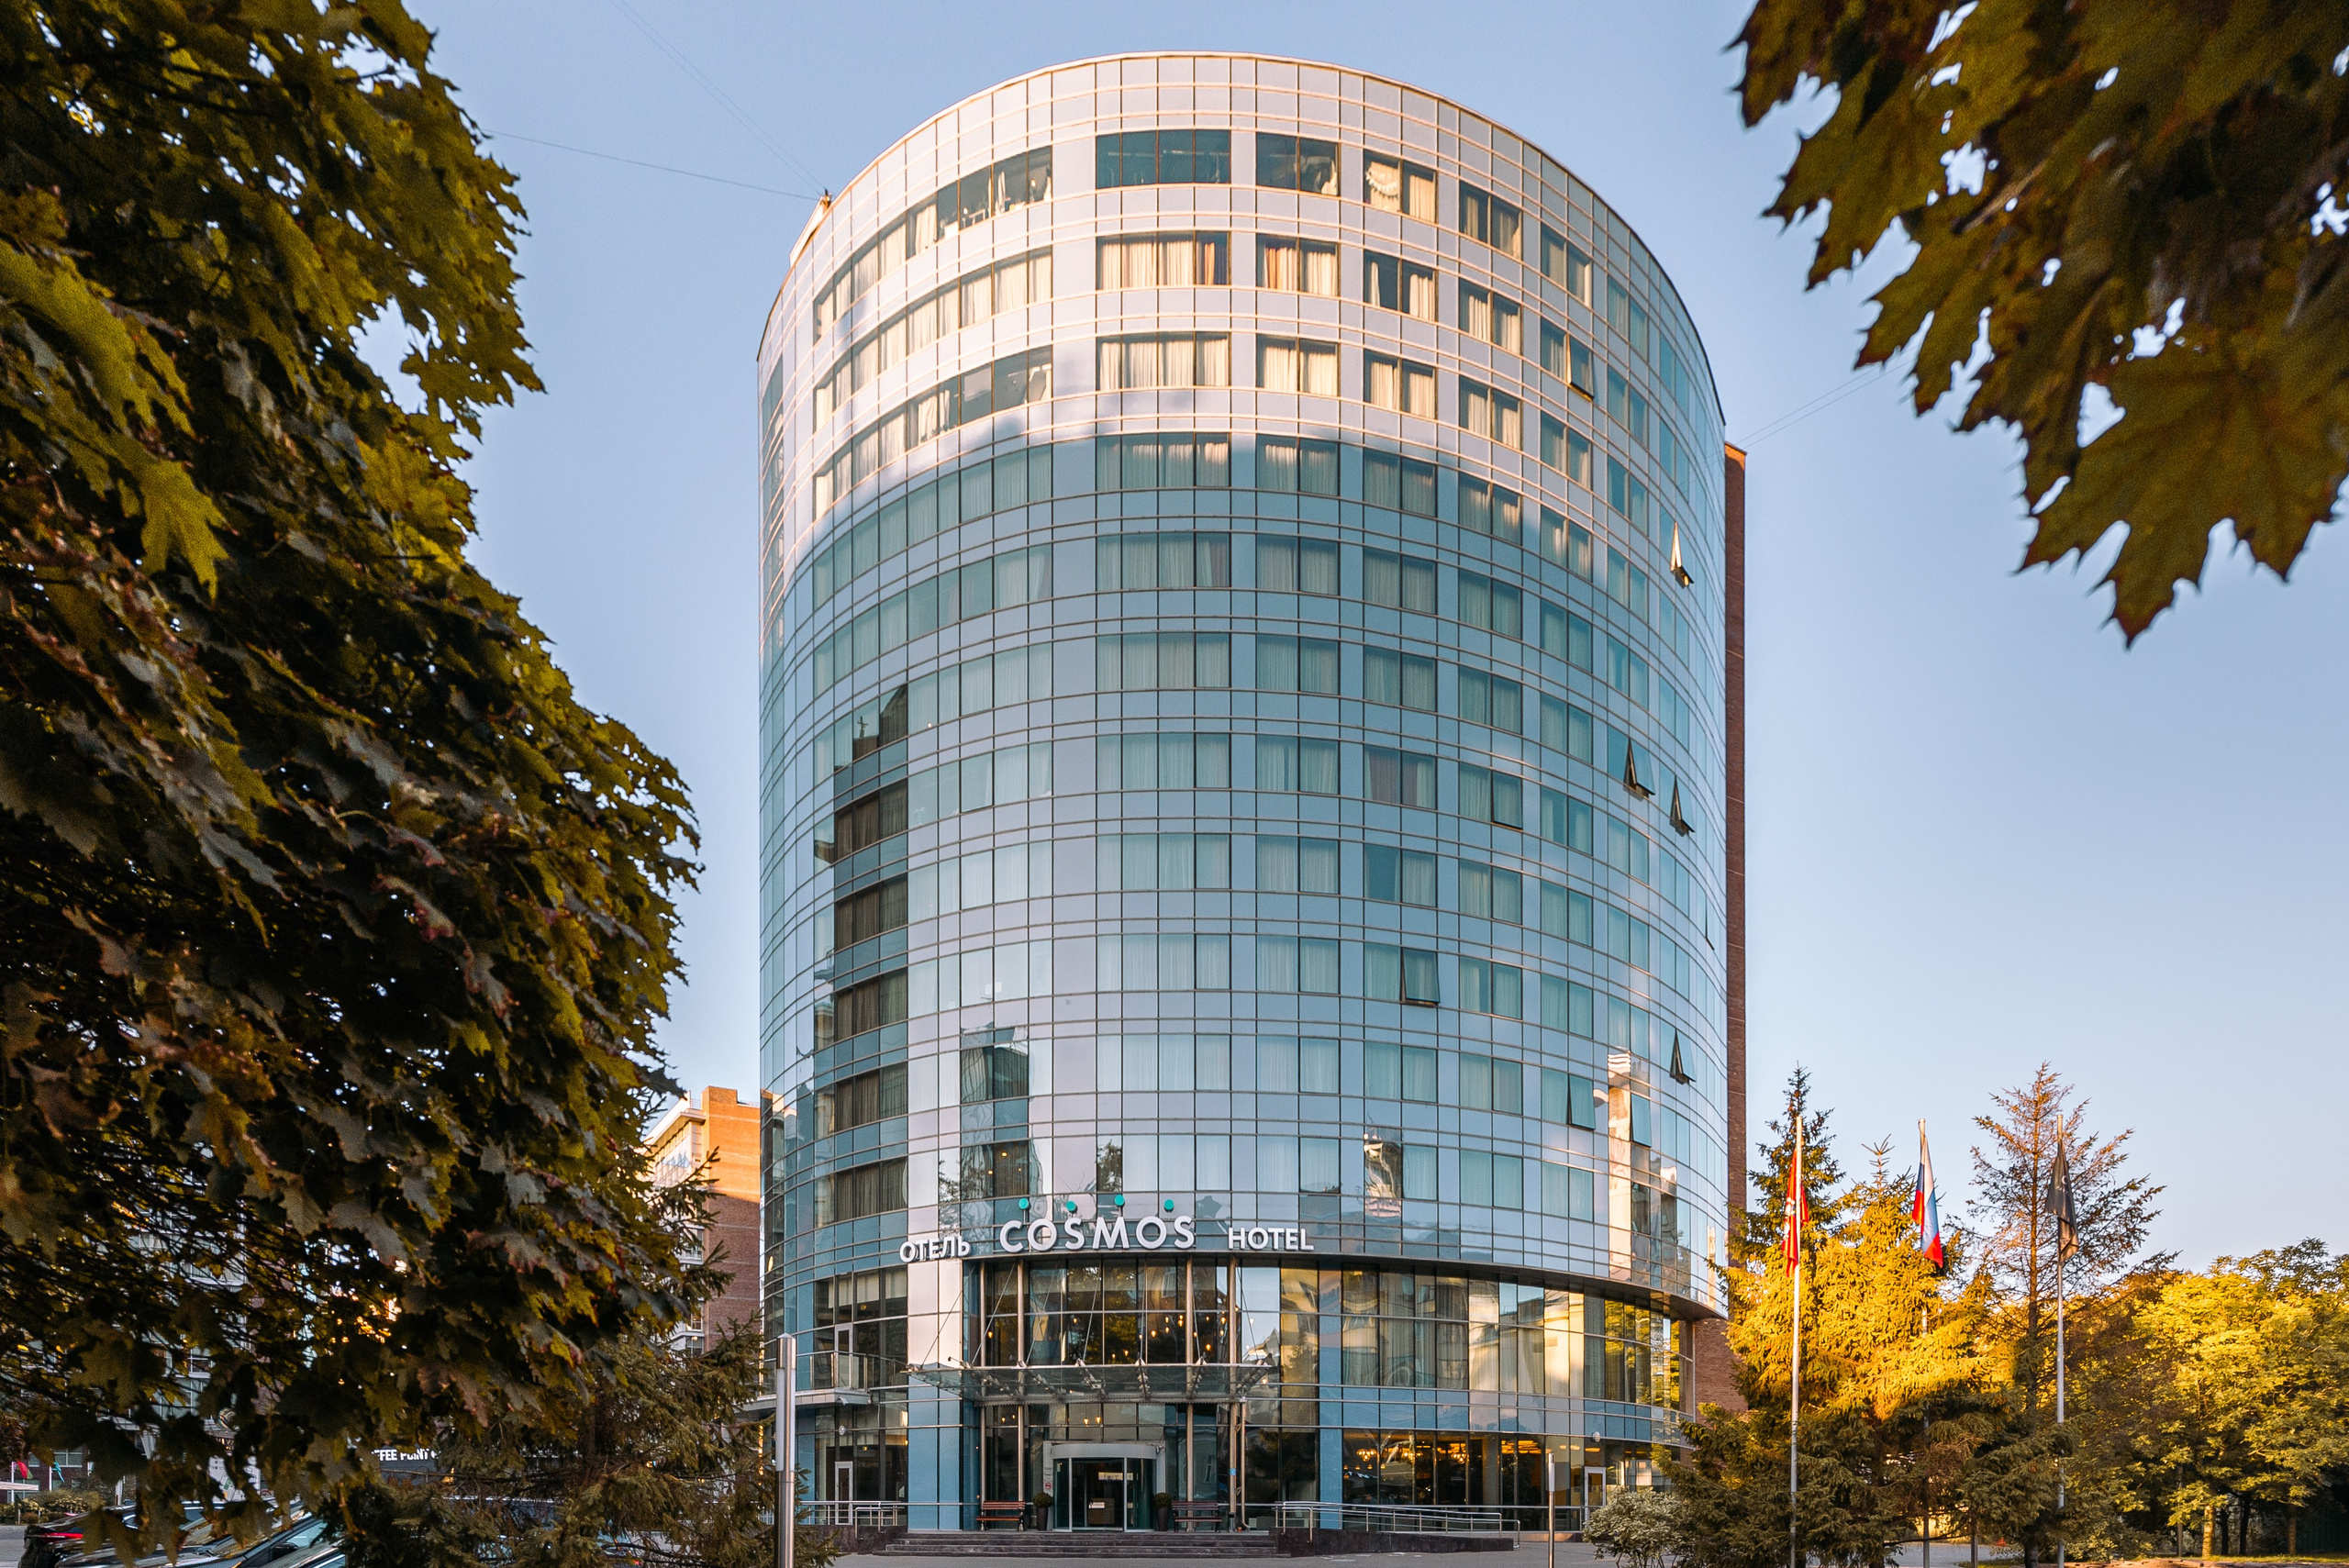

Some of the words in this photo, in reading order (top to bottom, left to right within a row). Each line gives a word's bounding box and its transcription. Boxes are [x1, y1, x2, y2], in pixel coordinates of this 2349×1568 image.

[899, 1235, 971, 1263] ОТЕЛЬ
[999, 1216, 1195, 1253] COSMOS
[1228, 1227, 1315, 1251] HOTEL
